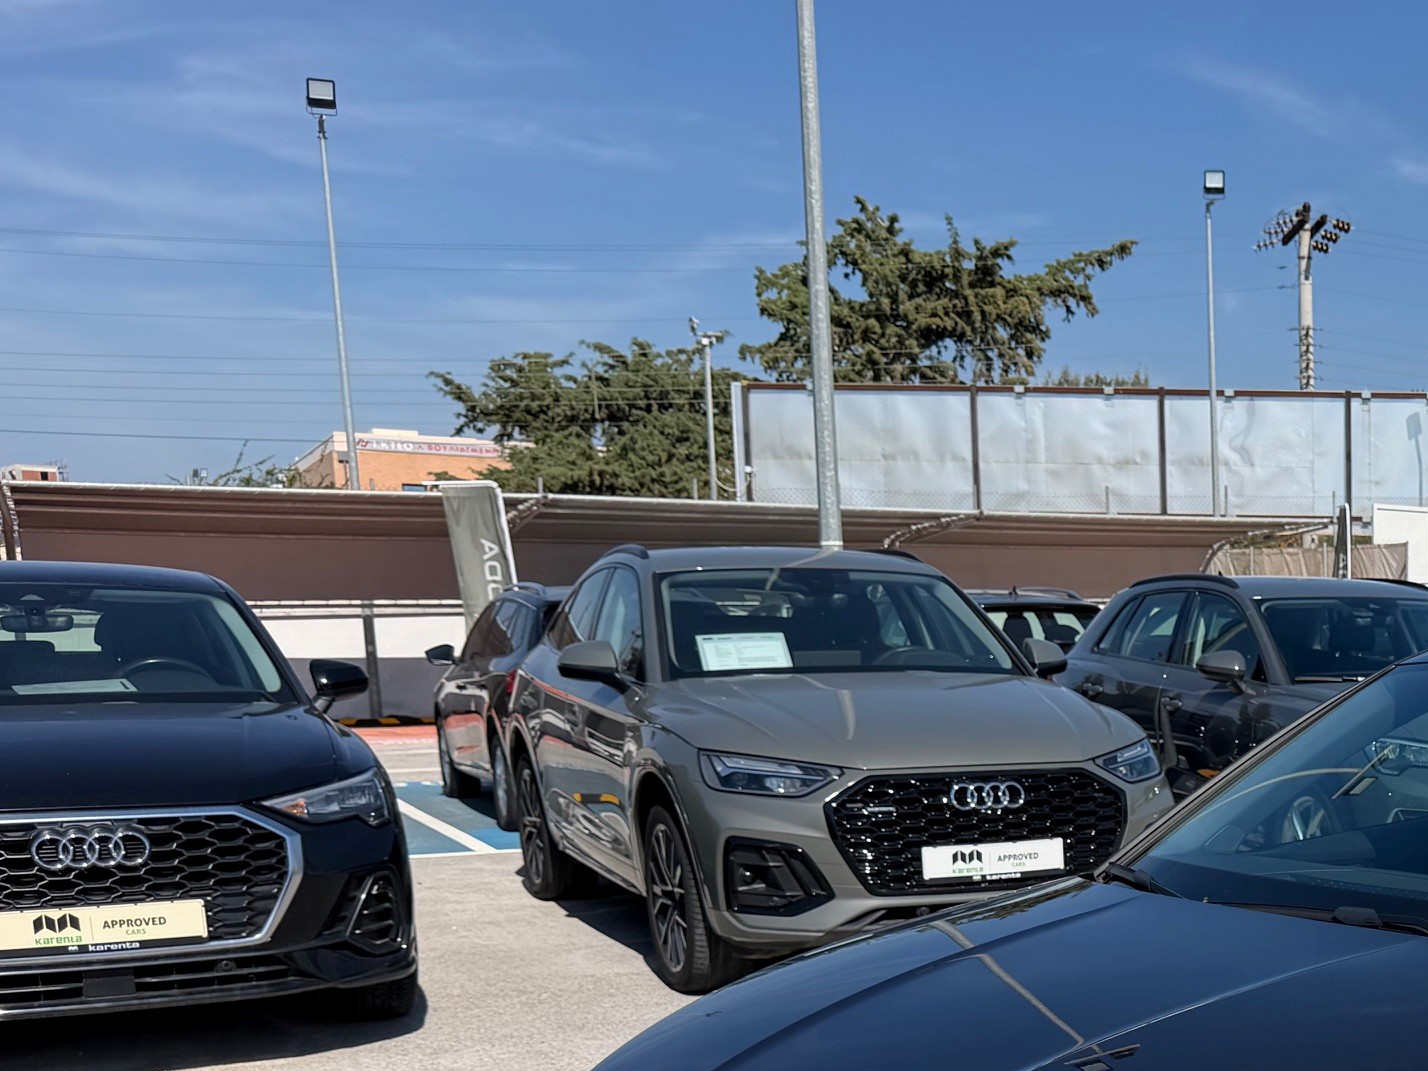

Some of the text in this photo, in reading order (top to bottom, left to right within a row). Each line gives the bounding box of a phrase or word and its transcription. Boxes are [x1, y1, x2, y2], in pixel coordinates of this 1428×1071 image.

[997, 852, 1039, 862] APPROVED
[102, 916, 167, 929] APPROVED
[125, 928, 147, 936] CARS
[35, 935, 83, 946] karenta
[88, 942, 140, 952] karenta
